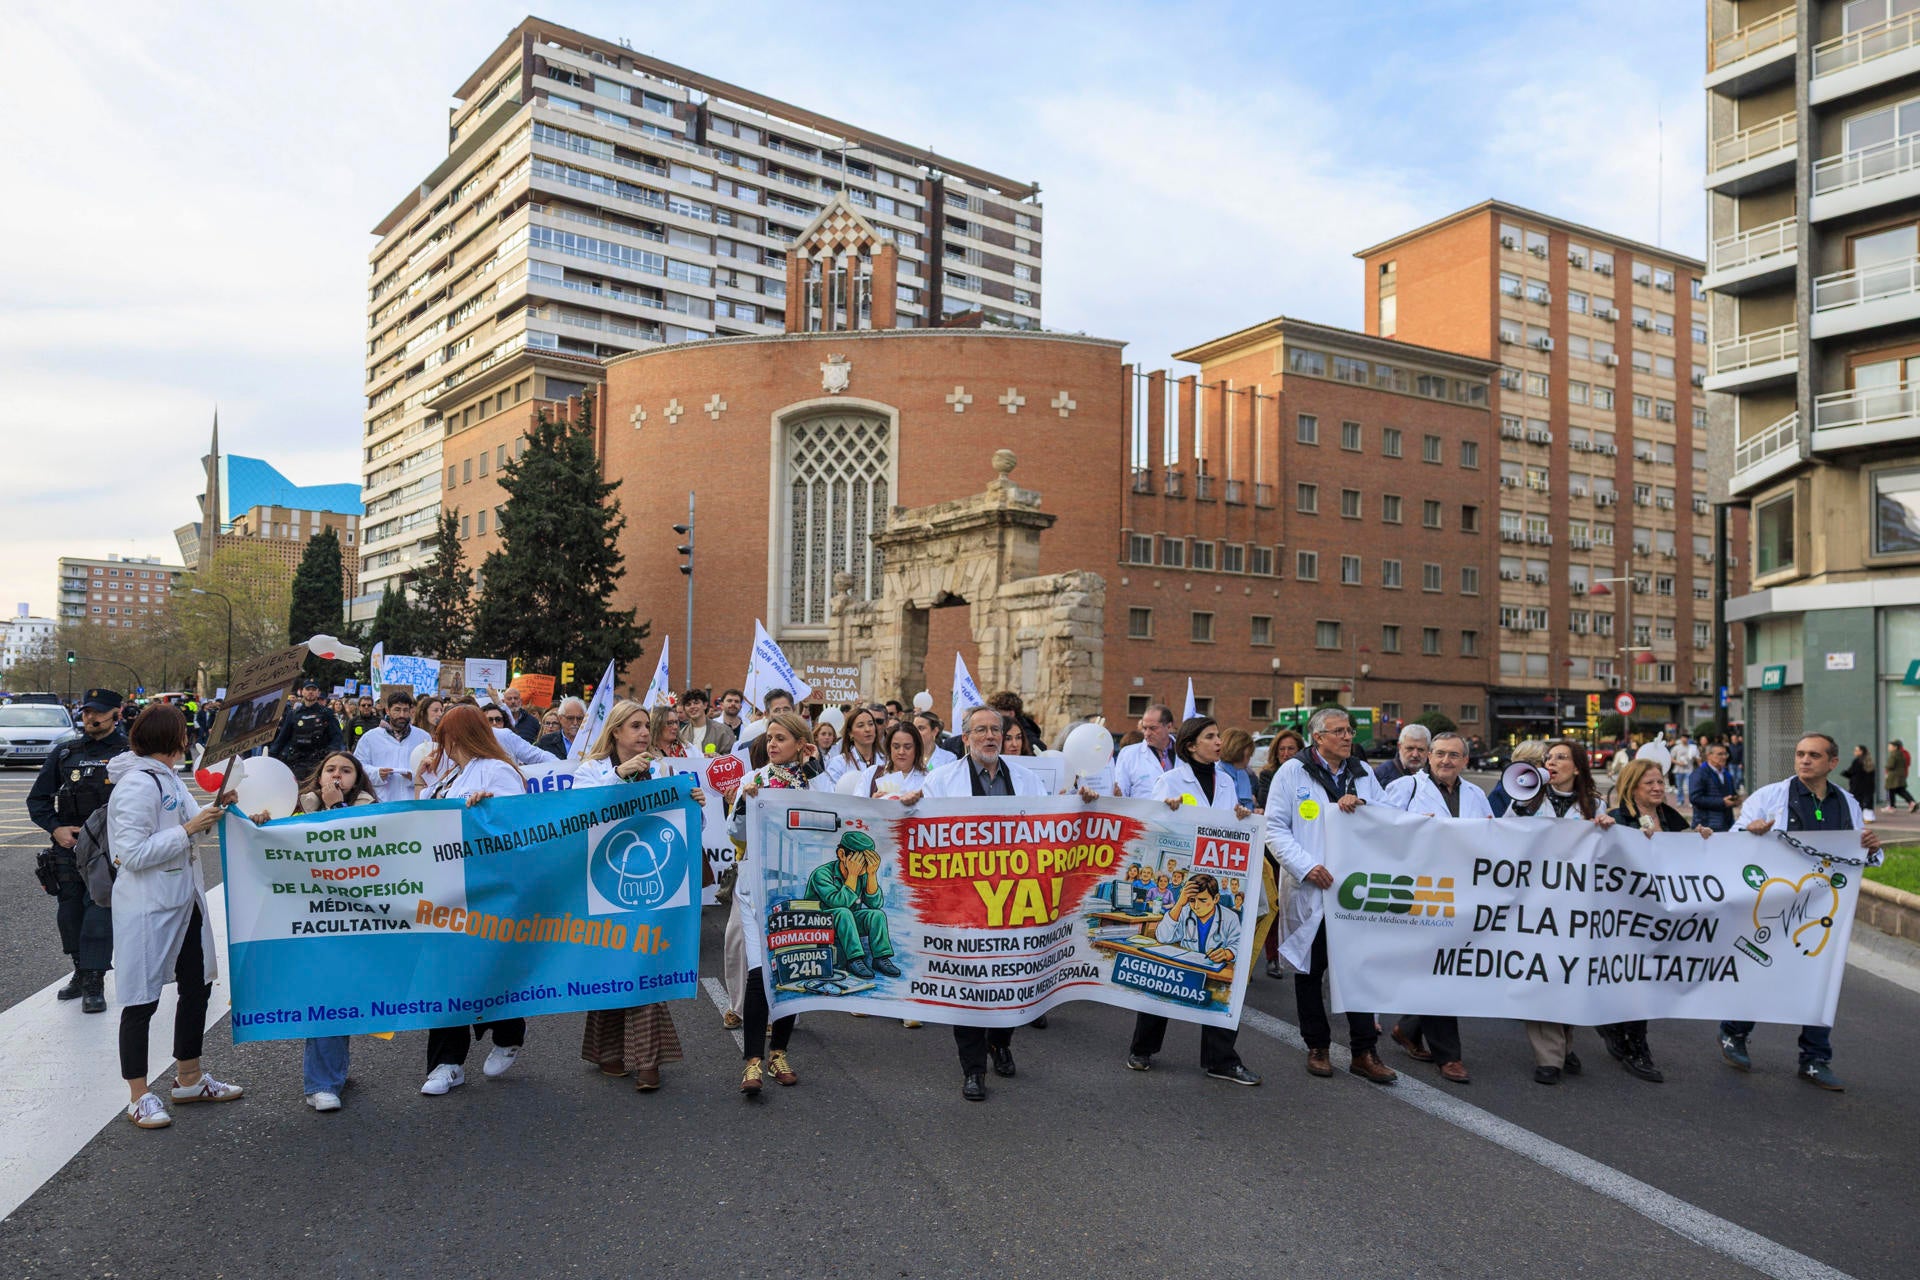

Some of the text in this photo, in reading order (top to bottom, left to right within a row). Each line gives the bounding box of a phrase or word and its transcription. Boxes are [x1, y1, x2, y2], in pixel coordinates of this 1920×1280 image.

[807, 665, 814, 674] DE
[824, 675, 856, 689] MÉDICA
[712, 761, 737, 774] STOP
[306, 826, 377, 844] POR UN
[433, 842, 473, 862] HORA
[601, 786, 680, 824] COMPUTADA
[908, 819, 1122, 850] ¡NECESITAMOS UN
[1197, 826, 1250, 841] RECONOCIMIENTO
[265, 841, 422, 862] ESTATUTO MARCO
[1158, 838, 1191, 848] CONSULTA
[1200, 841, 1245, 867] A1+
[311, 864, 380, 880] PROPIO
[908, 844, 1114, 879] ESTATUTO PROPIO
[272, 879, 423, 898] DE LA PROFESIÓN
[1472, 858, 1725, 903] POR UN ESTATUTO
[310, 898, 391, 914] MÉDICA Y
[973, 877, 1064, 927] YA!
[1337, 871, 1455, 918] CESM
[292, 919, 411, 934] FACULTATIVA
[416, 899, 670, 955] Reconocimiento A1+
[770, 914, 833, 929] +11-12 AÑOS
[1334, 912, 1367, 921] Sindicato
[1379, 916, 1408, 925] Médicos
[1409, 917, 1419, 926] de
[1419, 918, 1455, 927] ARAGÓN
[1473, 904, 1719, 943] DE LA PROFESIÓN
[771, 930, 830, 947] FORMACIÓN
[924, 922, 1074, 952] POR NUESTRA FORMACIÓN
[782, 951, 828, 964] GUARDIAS
[928, 946, 1075, 978] MÁXIMA RESPONSABILIDAD
[1432, 942, 1740, 986] MÉDICA Y FACULTATIVA
[789, 961, 822, 979] 24h
[1120, 957, 1184, 982] AGENDAS
[911, 963, 1100, 1003] POR LA SANIDAD QUE MERECE ESPAÑA
[1118, 970, 1206, 1001] DESBORDADAS
[232, 1008, 301, 1027] Nuestra
[308, 1006, 364, 1021] Mesa.
[371, 999, 442, 1017] Nuestra
[449, 985, 562, 1014] Negociación.
[568, 979, 633, 996] Nuestro
